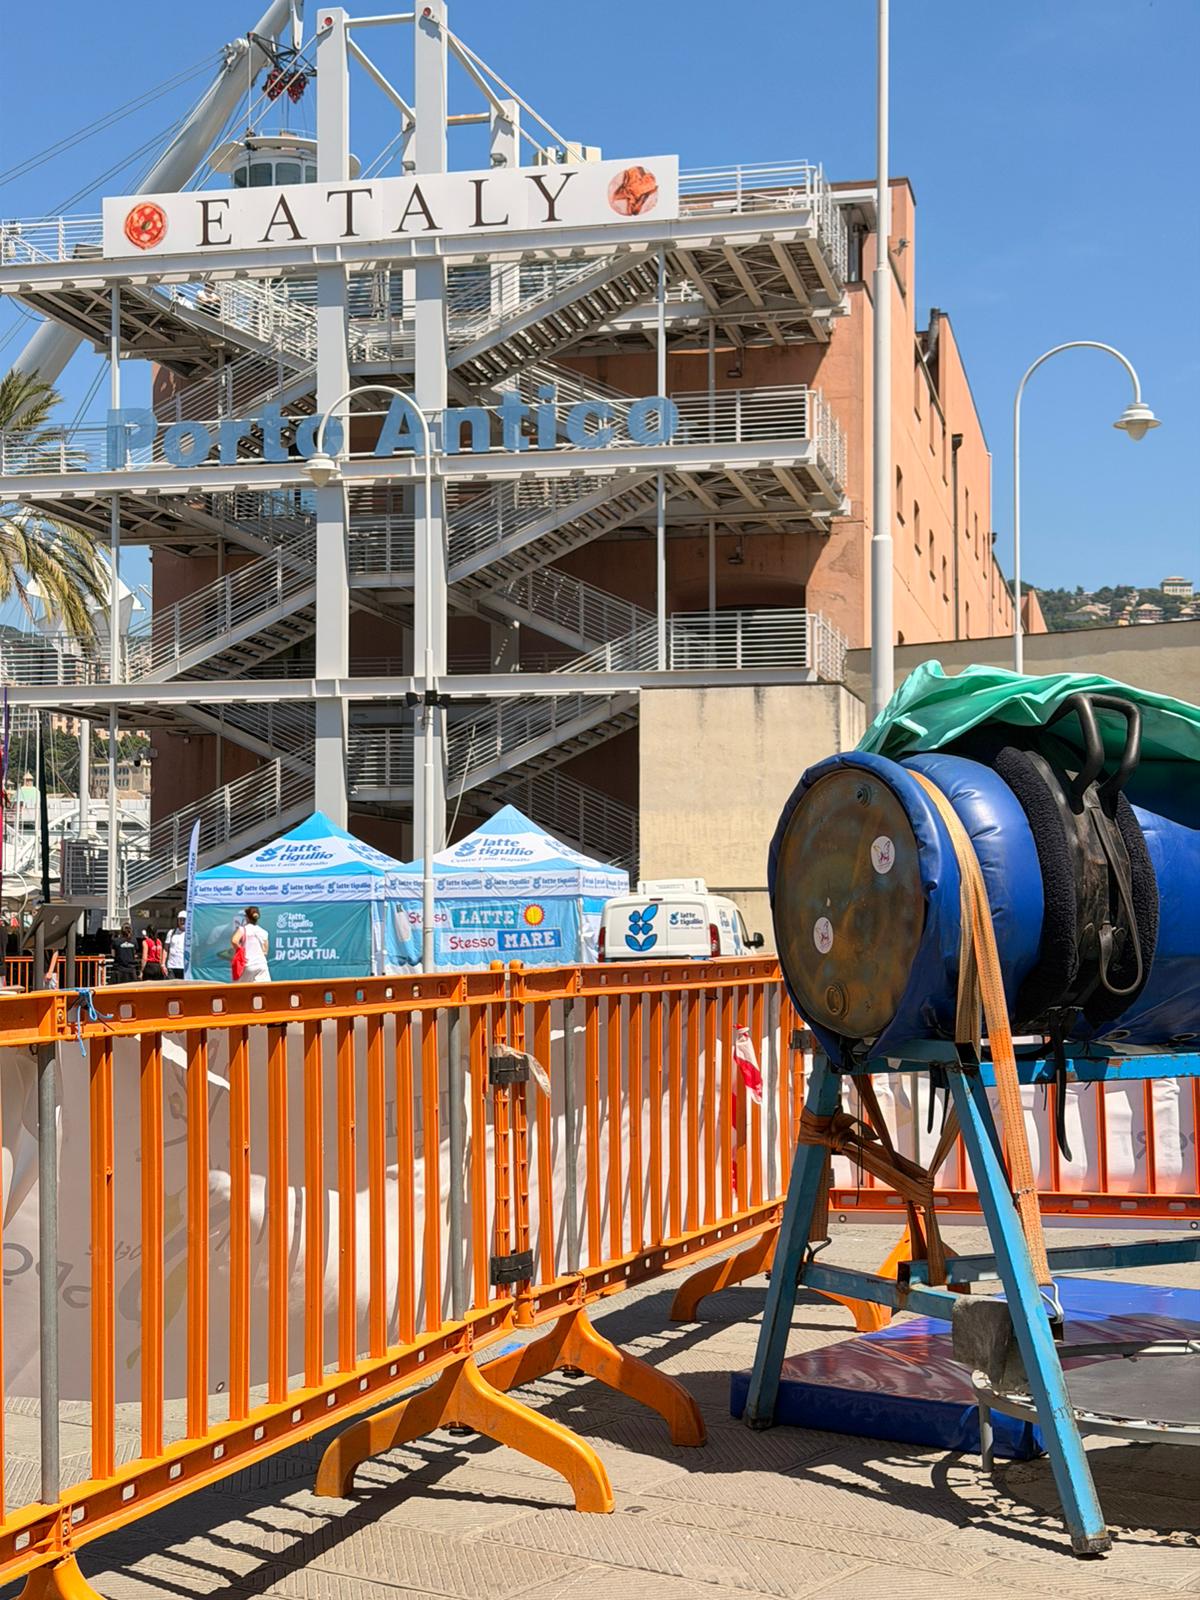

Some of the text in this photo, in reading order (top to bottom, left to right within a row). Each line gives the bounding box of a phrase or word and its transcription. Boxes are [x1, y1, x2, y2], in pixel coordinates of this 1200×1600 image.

[196, 172, 579, 248] EATALY
[107, 384, 679, 471] Porto Antico
[284, 843, 322, 852] latte
[482, 838, 520, 847] latte
[279, 852, 334, 862] tigullio
[479, 847, 534, 856] tigullio
[408, 910, 515, 925] Stso LATTE
[275, 936, 318, 948] IL LATTE
[449, 931, 555, 950] Stesso MARE
[275, 948, 340, 961] DI CASA TUA.
